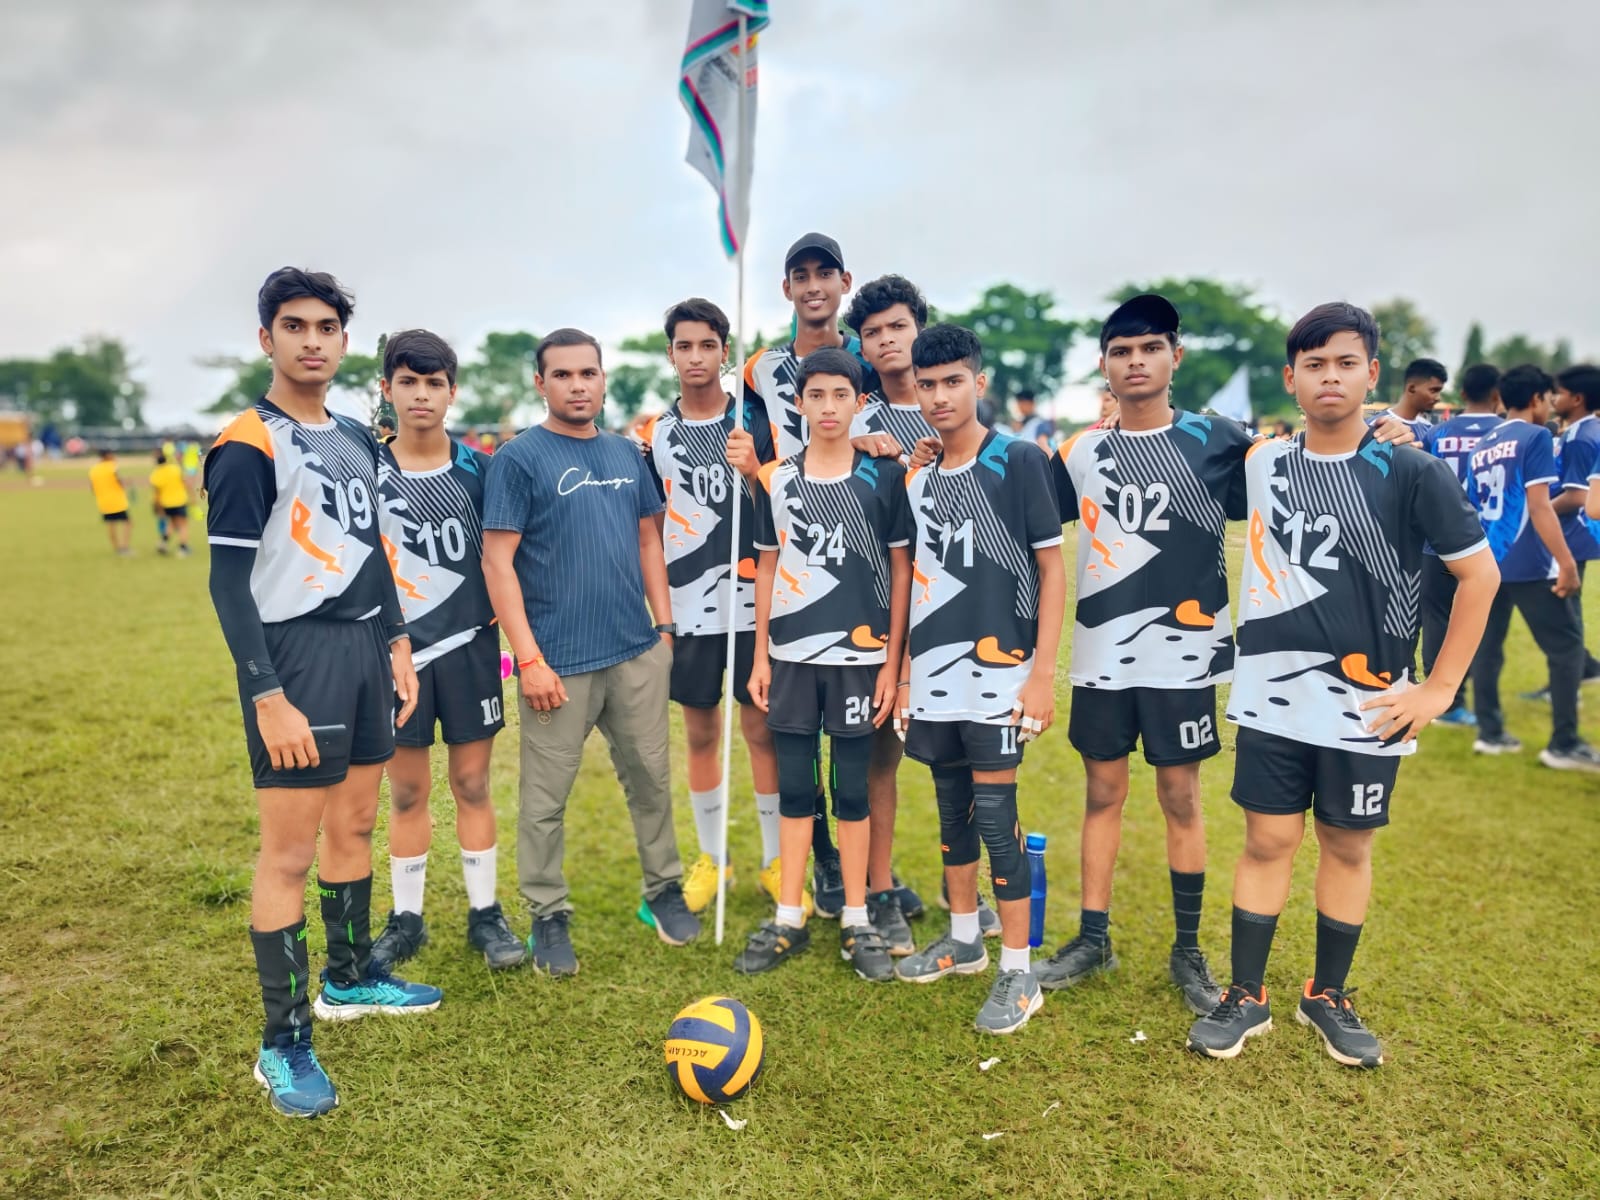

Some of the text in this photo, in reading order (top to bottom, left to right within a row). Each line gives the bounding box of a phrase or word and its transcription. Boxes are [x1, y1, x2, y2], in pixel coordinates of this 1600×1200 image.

[335, 477, 372, 533] 09
[692, 463, 727, 505] 08
[1118, 482, 1171, 533] 02
[416, 517, 466, 566] 10
[806, 522, 846, 566] 24
[939, 518, 974, 567] 11
[1283, 509, 1341, 570] 12
[481, 696, 501, 725] 10
[845, 696, 870, 725] 24
[1178, 714, 1215, 749] 02
[1001, 727, 1017, 754] 11
[1350, 783, 1384, 815] 12
